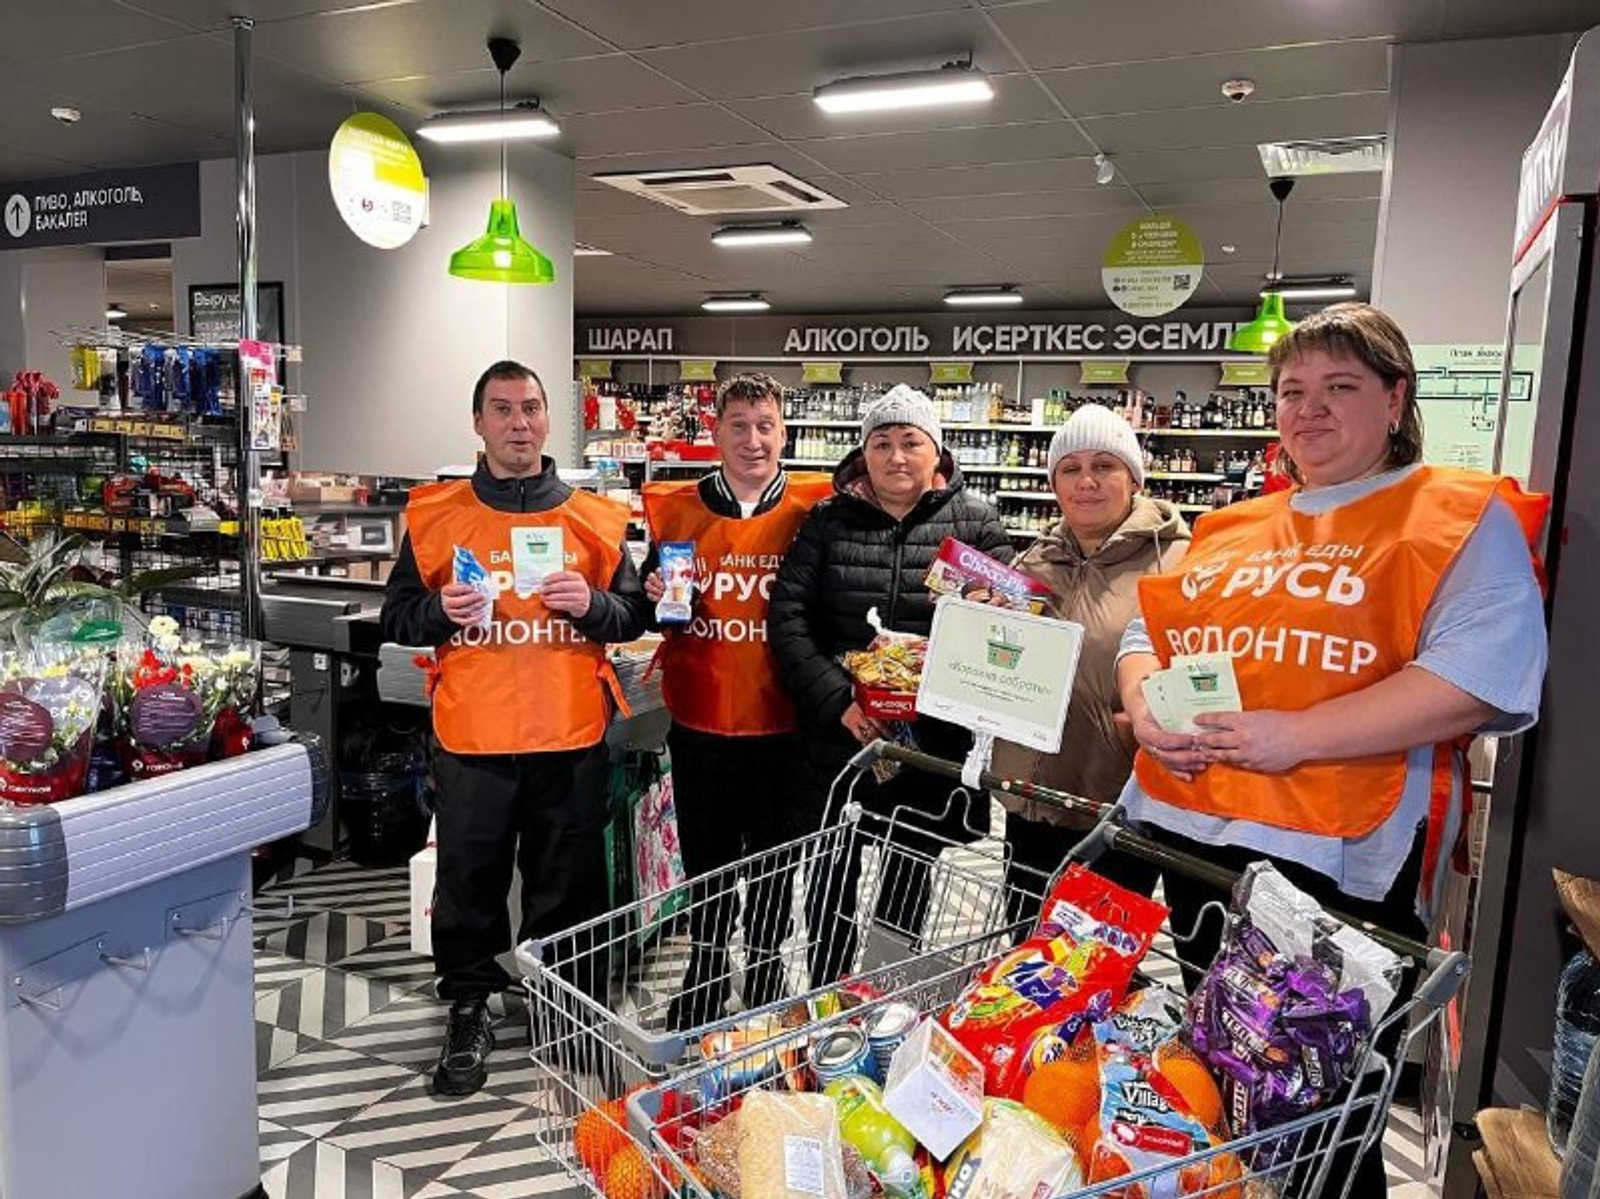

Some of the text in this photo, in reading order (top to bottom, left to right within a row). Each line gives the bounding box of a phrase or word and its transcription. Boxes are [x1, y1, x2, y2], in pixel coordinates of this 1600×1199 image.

[35, 186, 144, 211] ПИВО, АЛКОГОЛЬ,
[36, 210, 88, 231] БАКАЛЕЯ
[588, 327, 673, 351] ШАРАП
[783, 326, 931, 352] АЛКОГОЛЬ
[1112, 322, 1251, 351] ЭСЕМЛ
[758, 554, 785, 570] ЕД
[1246, 543, 1364, 563] БАНК ЕДЫ
[713, 571, 777, 602] РУС
[1220, 561, 1366, 606] РУСЬ
[450, 618, 587, 647] ОЛОНТЕ
[1165, 625, 1378, 675] ВОЛОНТЕР
